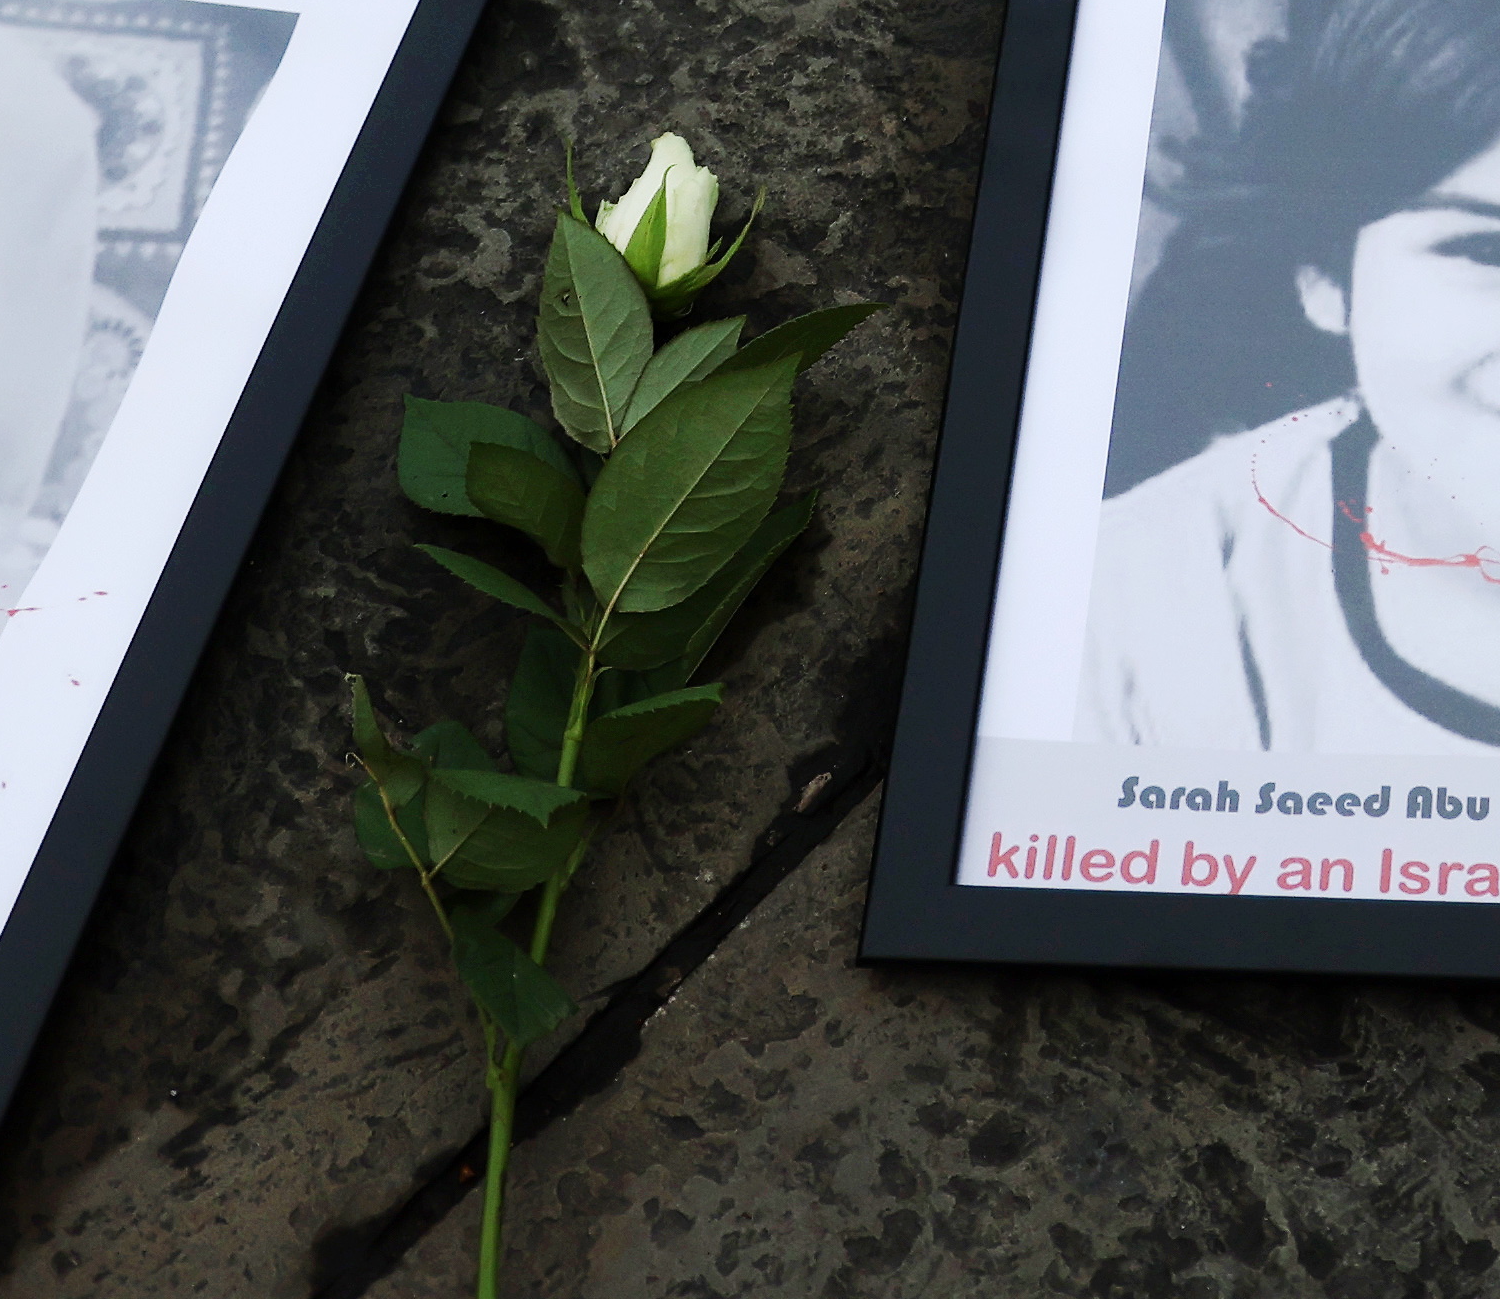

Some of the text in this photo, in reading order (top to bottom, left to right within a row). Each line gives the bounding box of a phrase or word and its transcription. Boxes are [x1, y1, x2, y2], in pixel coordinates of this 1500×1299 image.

[1117, 776, 1240, 812] Sarah
[1255, 782, 1391, 818] Saeed
[1406, 786, 1490, 821] Abu
[989, 833, 1159, 883] killed
[1182, 842, 1256, 894] by
[1278, 858, 1353, 891] an
